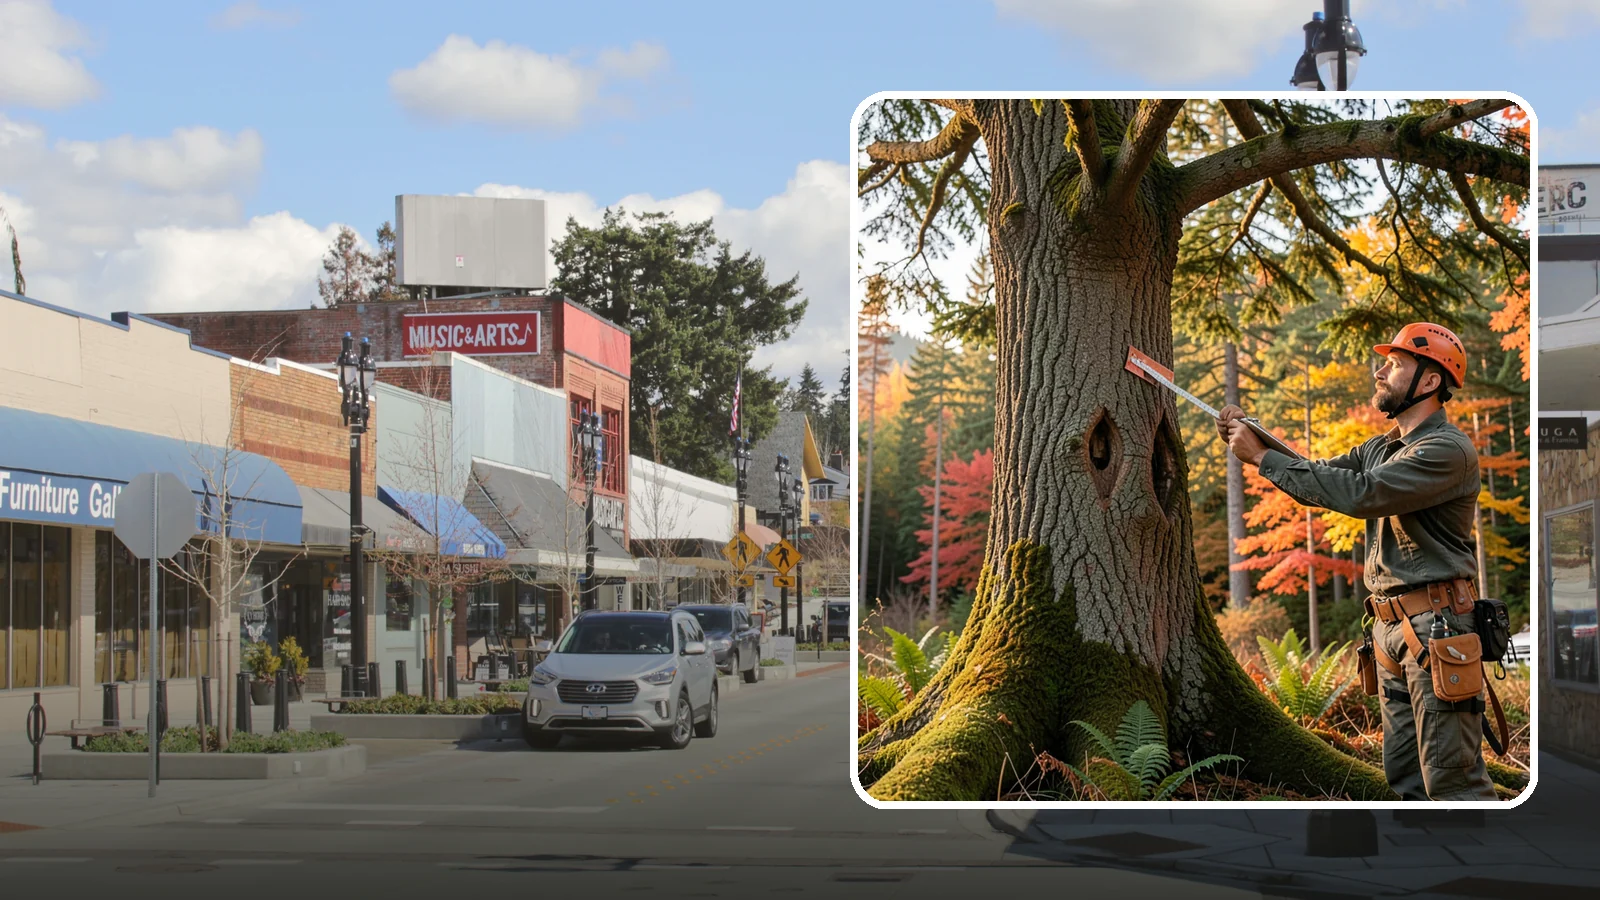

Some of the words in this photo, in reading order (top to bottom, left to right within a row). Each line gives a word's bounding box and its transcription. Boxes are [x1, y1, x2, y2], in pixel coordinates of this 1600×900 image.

[0, 471, 79, 515] Furniture
[89, 482, 121, 519] Gal
[453, 563, 479, 574] SUSHI
